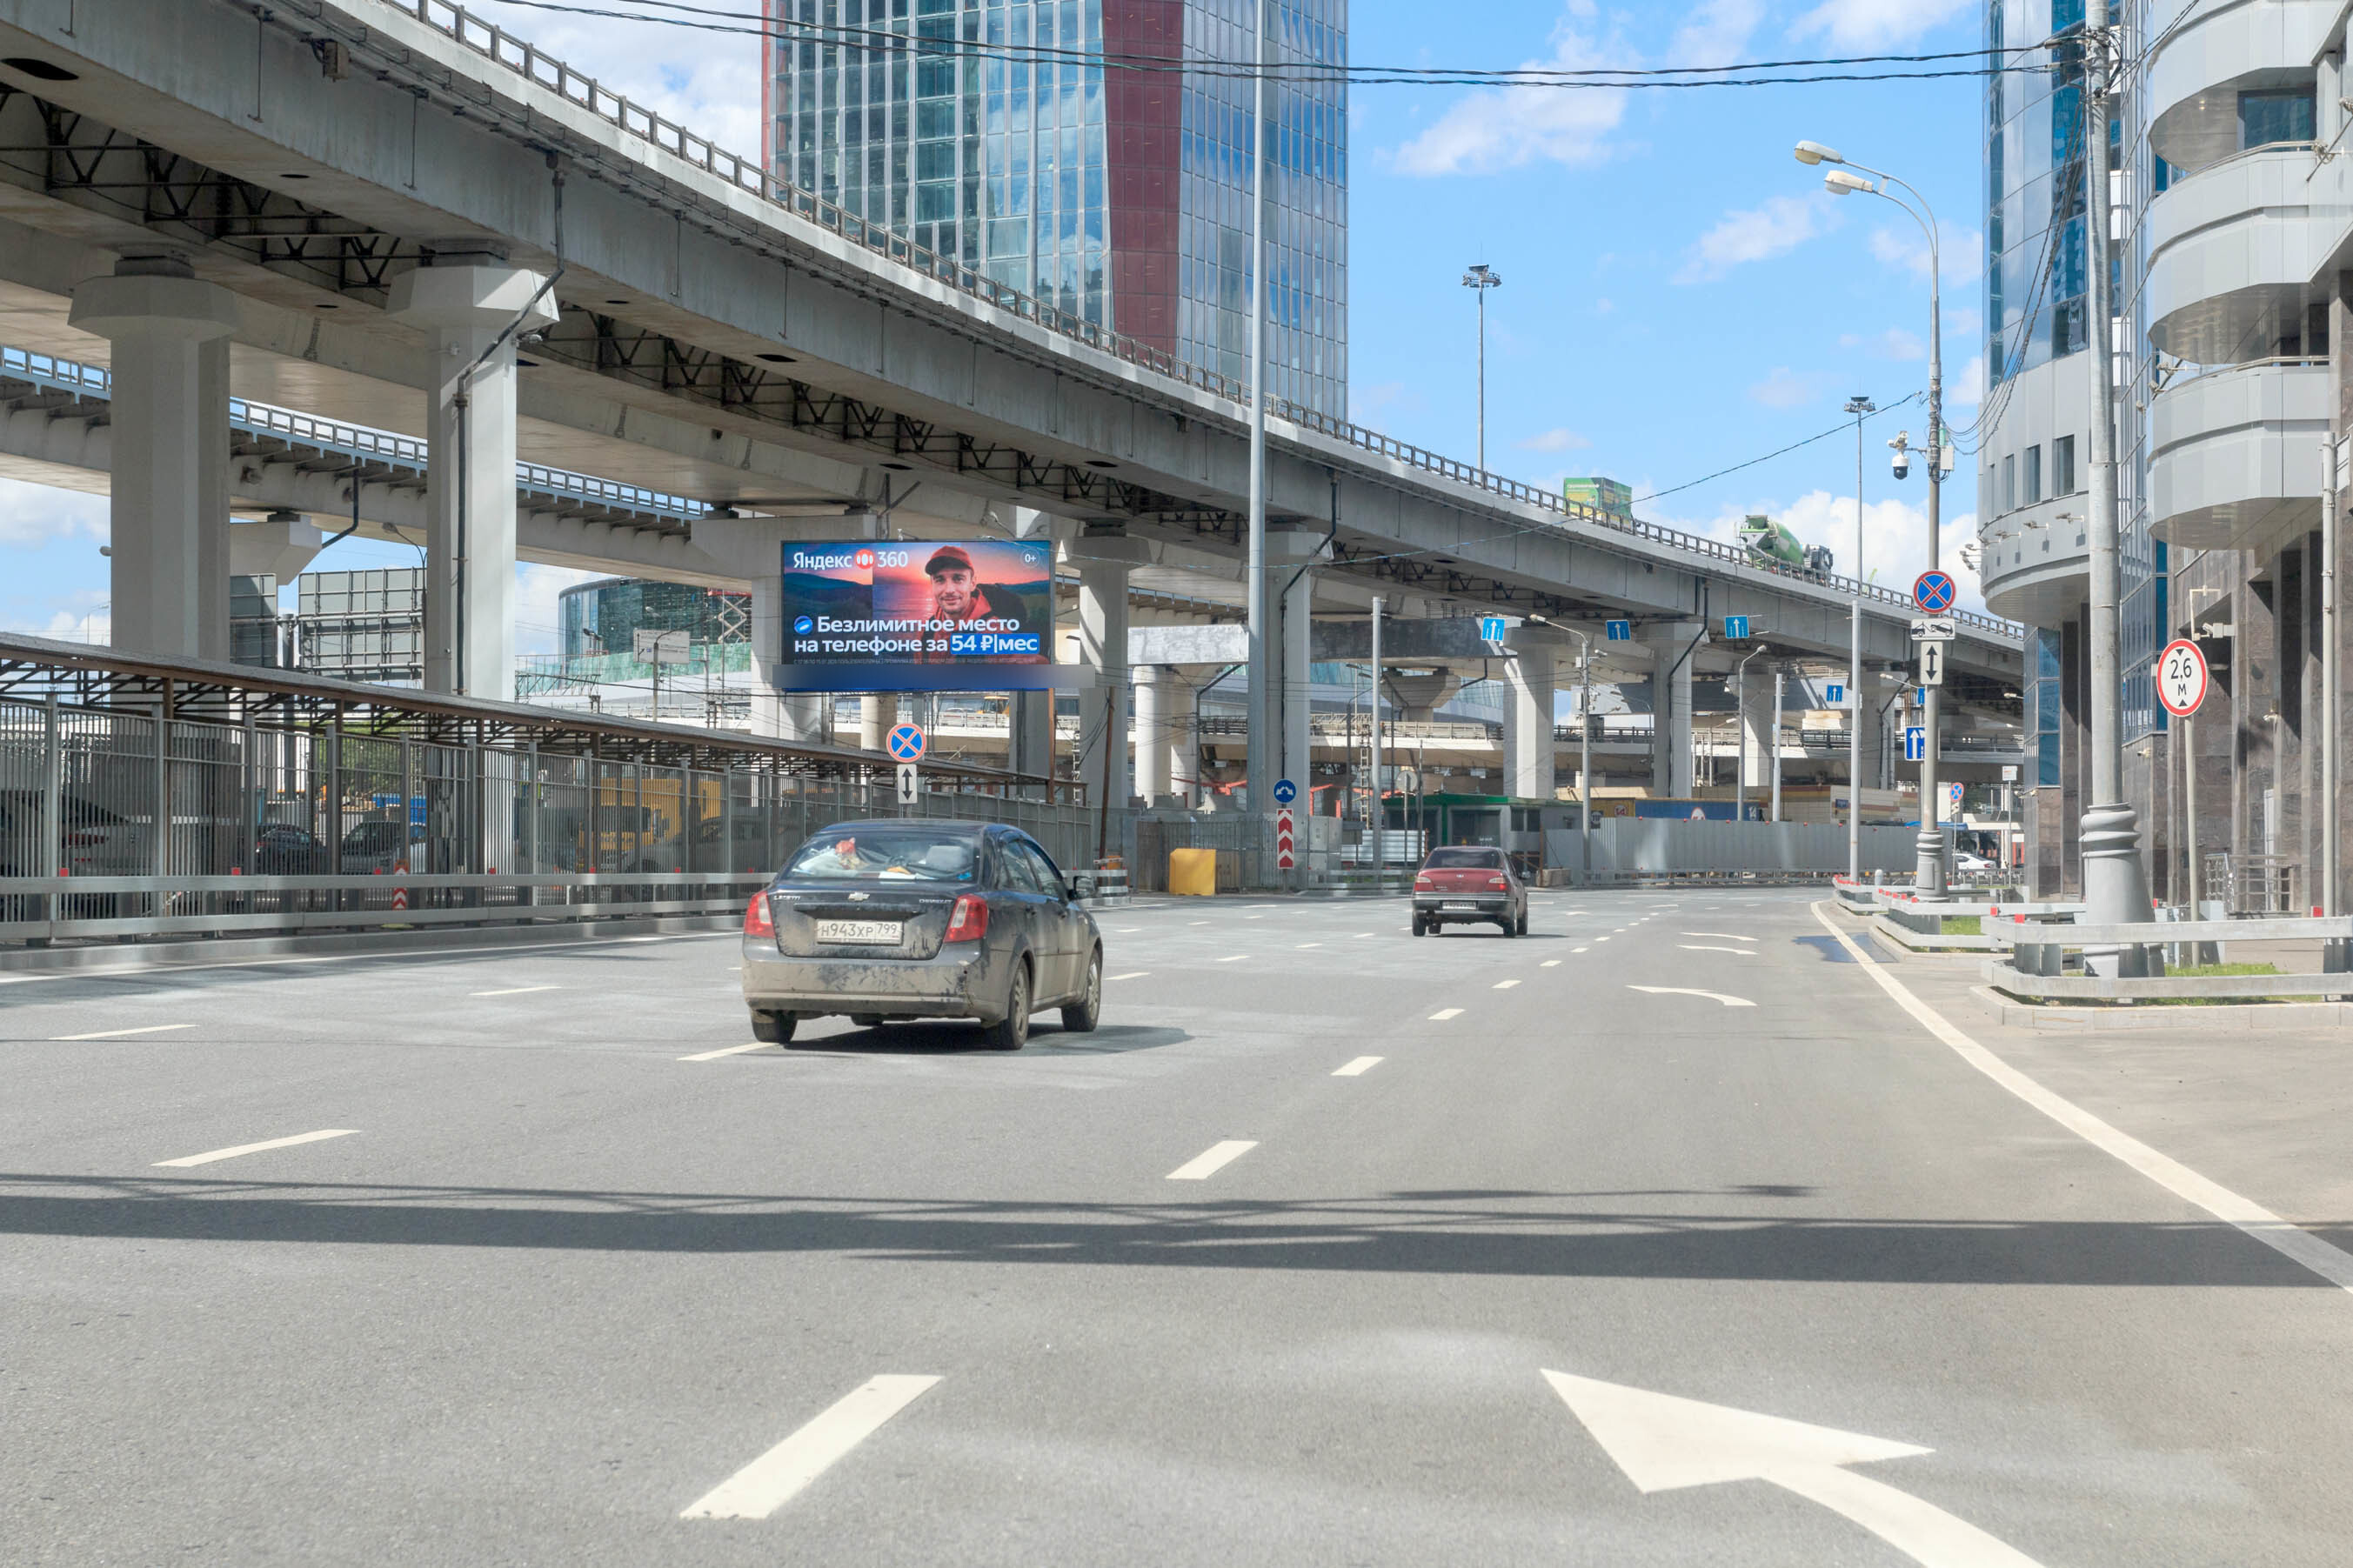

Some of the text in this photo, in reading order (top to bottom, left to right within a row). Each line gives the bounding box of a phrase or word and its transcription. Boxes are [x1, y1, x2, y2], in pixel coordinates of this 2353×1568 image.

[793, 551, 908, 570] Яндекс 360
[1024, 553, 1037, 564] 0+
[817, 617, 1019, 632] Безлимитное место
[794, 639, 819, 652] на
[822, 637, 922, 655] телефоне
[926, 640, 948, 652] за
[952, 636, 977, 651] 54
[2170, 657, 2192, 682] 2,6
[877, 924, 898, 934] 799
